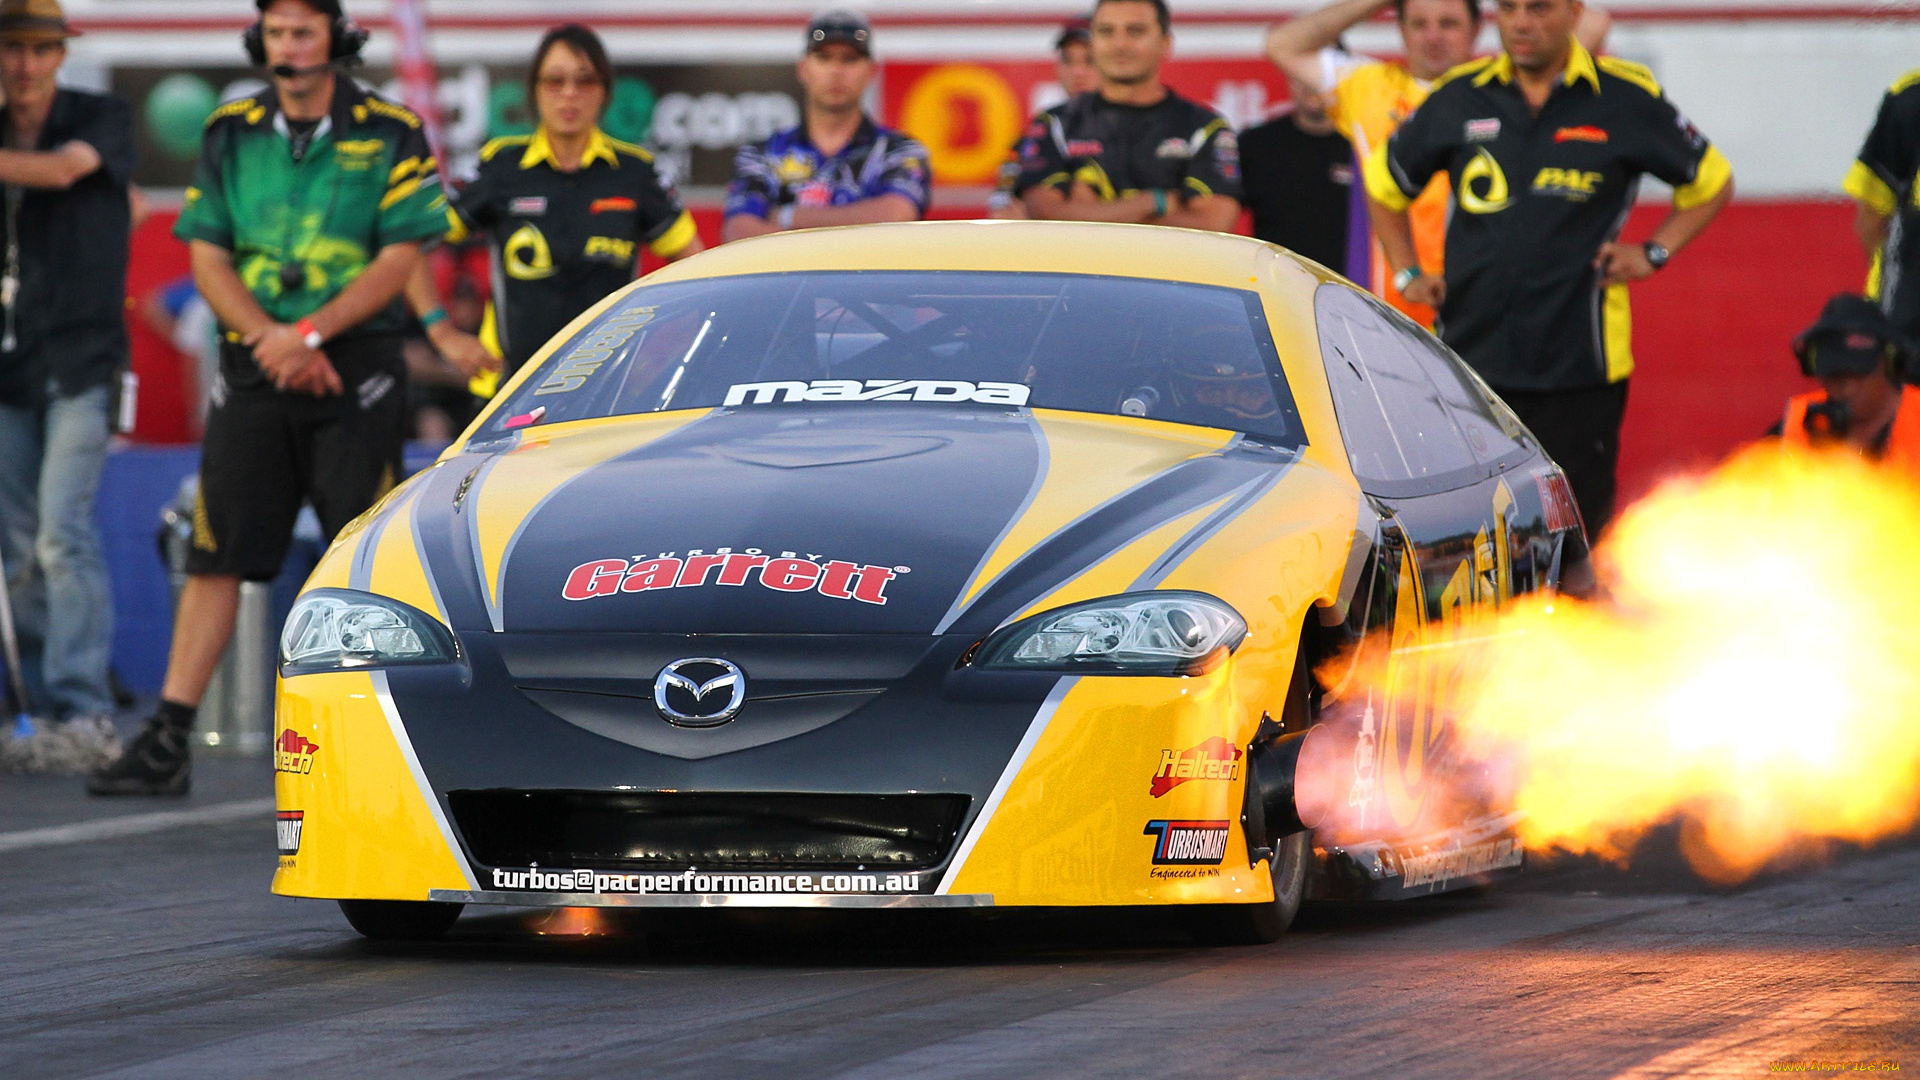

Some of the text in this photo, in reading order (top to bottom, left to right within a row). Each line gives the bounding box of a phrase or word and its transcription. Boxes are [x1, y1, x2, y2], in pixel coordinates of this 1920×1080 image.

[631, 547, 823, 562] TURBO BY
[1156, 748, 1240, 781] Haltech
[1149, 820, 1229, 860] TURBOSMART
[492, 867, 920, 894] turbos@pacperformance.com.au
[1149, 867, 1198, 881] Engineered
[1198, 867, 1206, 878] to
